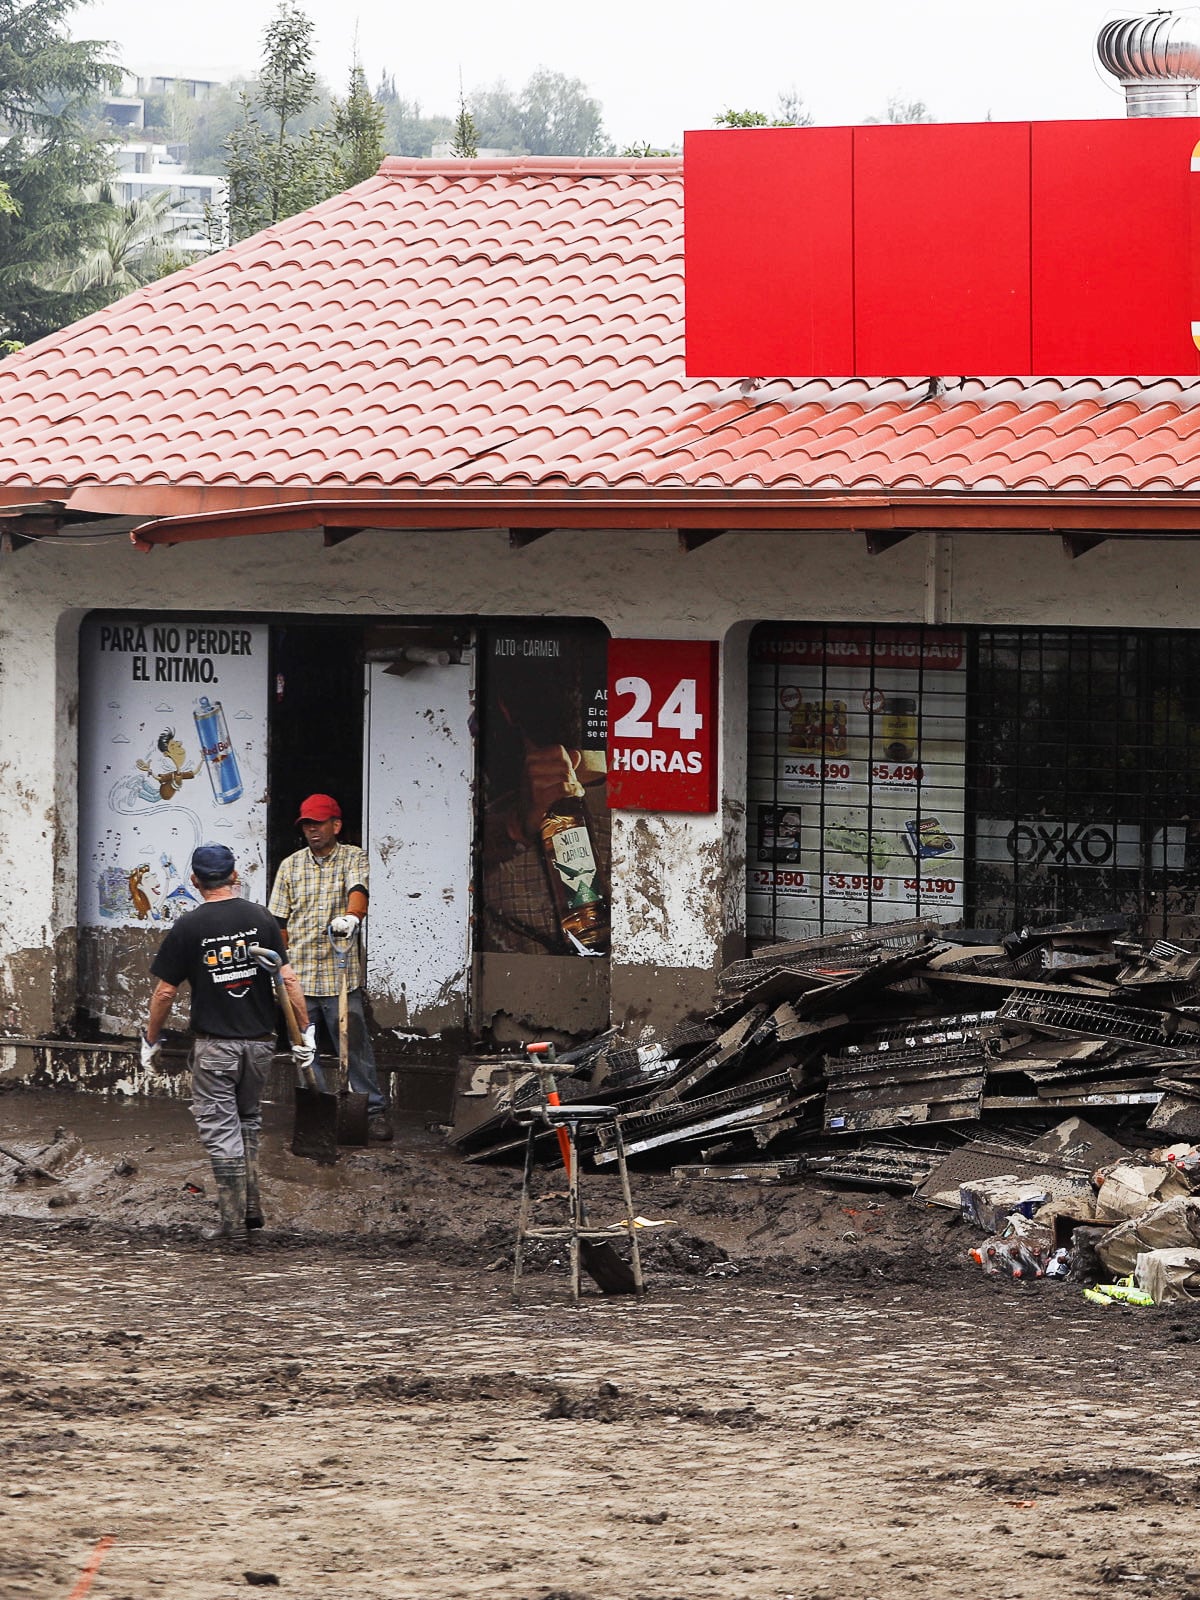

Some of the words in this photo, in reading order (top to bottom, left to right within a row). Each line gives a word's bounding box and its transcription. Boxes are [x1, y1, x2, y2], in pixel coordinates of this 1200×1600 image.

[100, 626, 148, 653] PARA
[152, 627, 180, 653] NO
[186, 628, 252, 656] PERDER
[495, 639, 516, 656] ALTO
[522, 640, 561, 657] CARMEN
[811, 641, 860, 657] PARA
[865, 642, 888, 657] TU
[890, 643, 960, 658] HOGAR!
[132, 656, 150, 681] EL
[155, 656, 219, 683] RITMO.
[614, 676, 703, 740] 24
[587, 730, 598, 738] se
[613, 748, 703, 774] HORAS
[785, 765, 799, 775] 2X
[872, 765, 924, 780] $5.490
[1007, 822, 1114, 864] OXXO
[828, 875, 884, 891] $3.990
[903, 878, 956, 894] $4.190
